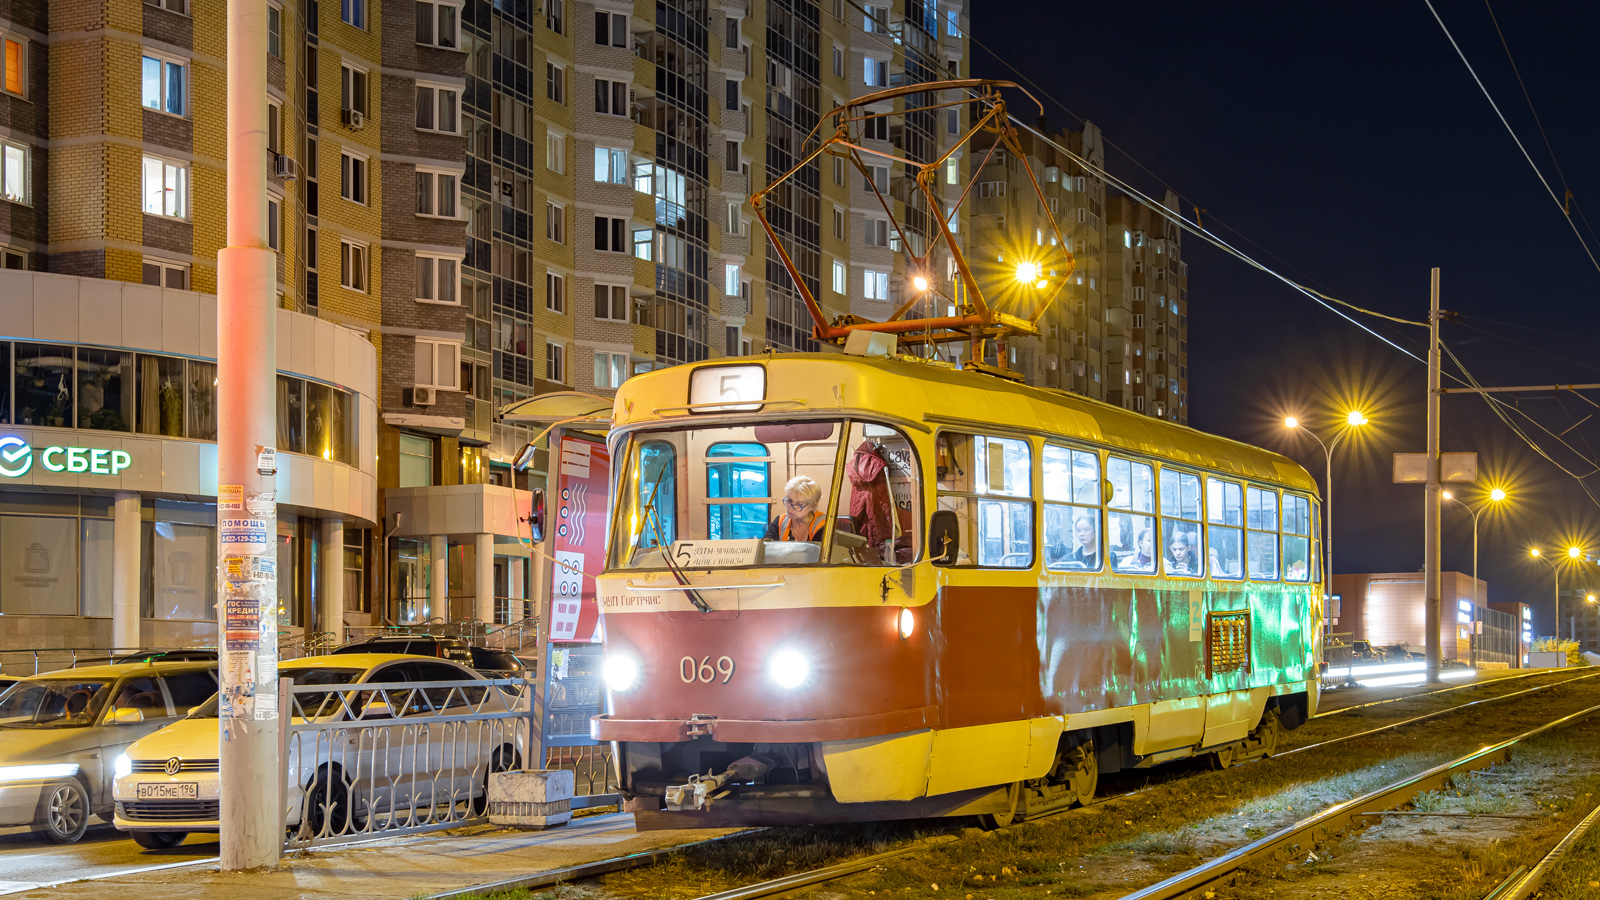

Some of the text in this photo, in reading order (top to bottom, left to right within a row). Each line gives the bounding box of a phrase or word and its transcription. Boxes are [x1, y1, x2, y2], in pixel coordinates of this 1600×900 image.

[719, 374, 742, 410] 5
[41, 446, 132, 476] СБЕР
[222, 519, 265, 529] ПОМОЩЬ
[675, 543, 694, 567] 5
[227, 607, 259, 615] КРЕДИТ
[679, 655, 736, 686] 069
[141, 784, 195, 797] В015МЕ 196
